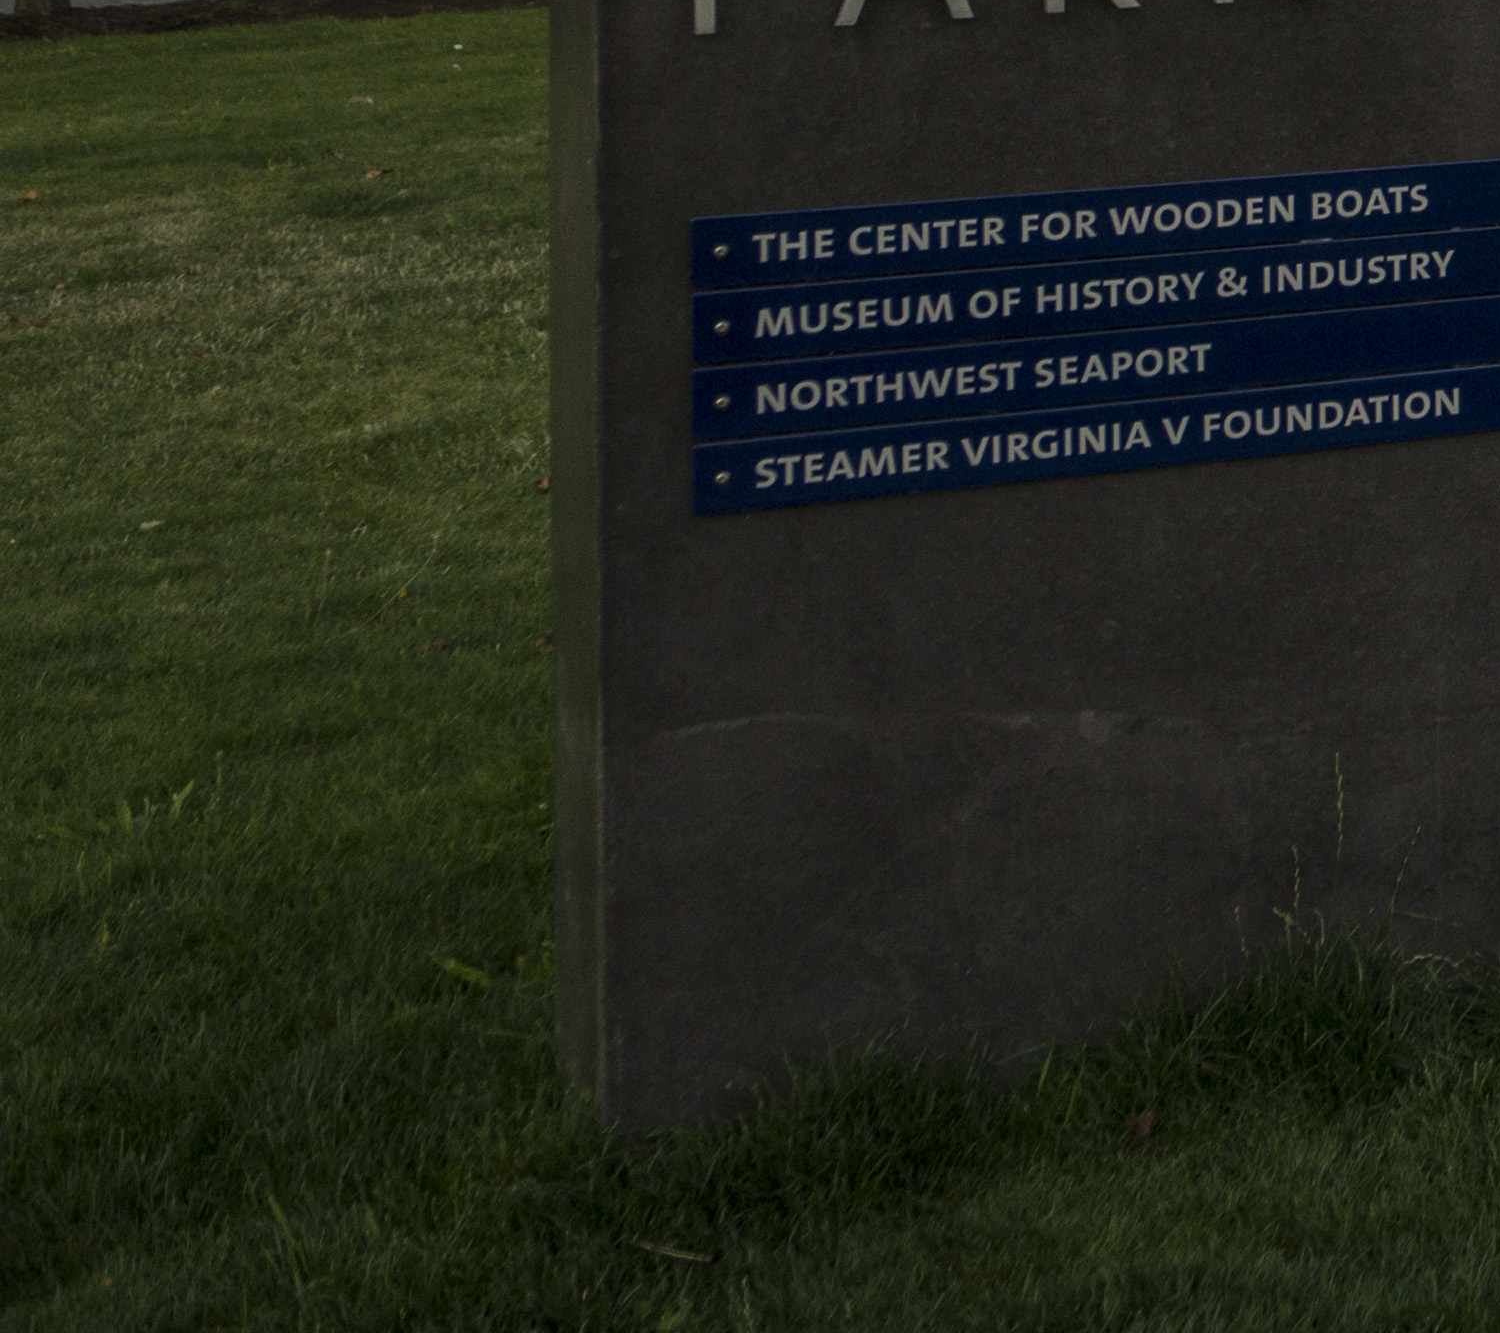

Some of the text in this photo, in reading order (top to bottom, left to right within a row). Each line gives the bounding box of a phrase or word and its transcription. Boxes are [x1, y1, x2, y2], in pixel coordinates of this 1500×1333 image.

[752, 184, 1428, 263] THE CENTER FOR WOODEN BOATS
[756, 249, 1455, 338] MUSEUM OF HISTORY & INDUSTRY
[757, 343, 1212, 414] NORTHWEST SEAPORT
[755, 387, 1460, 488] STEAMER VIRGINIA V FOUNDATION
